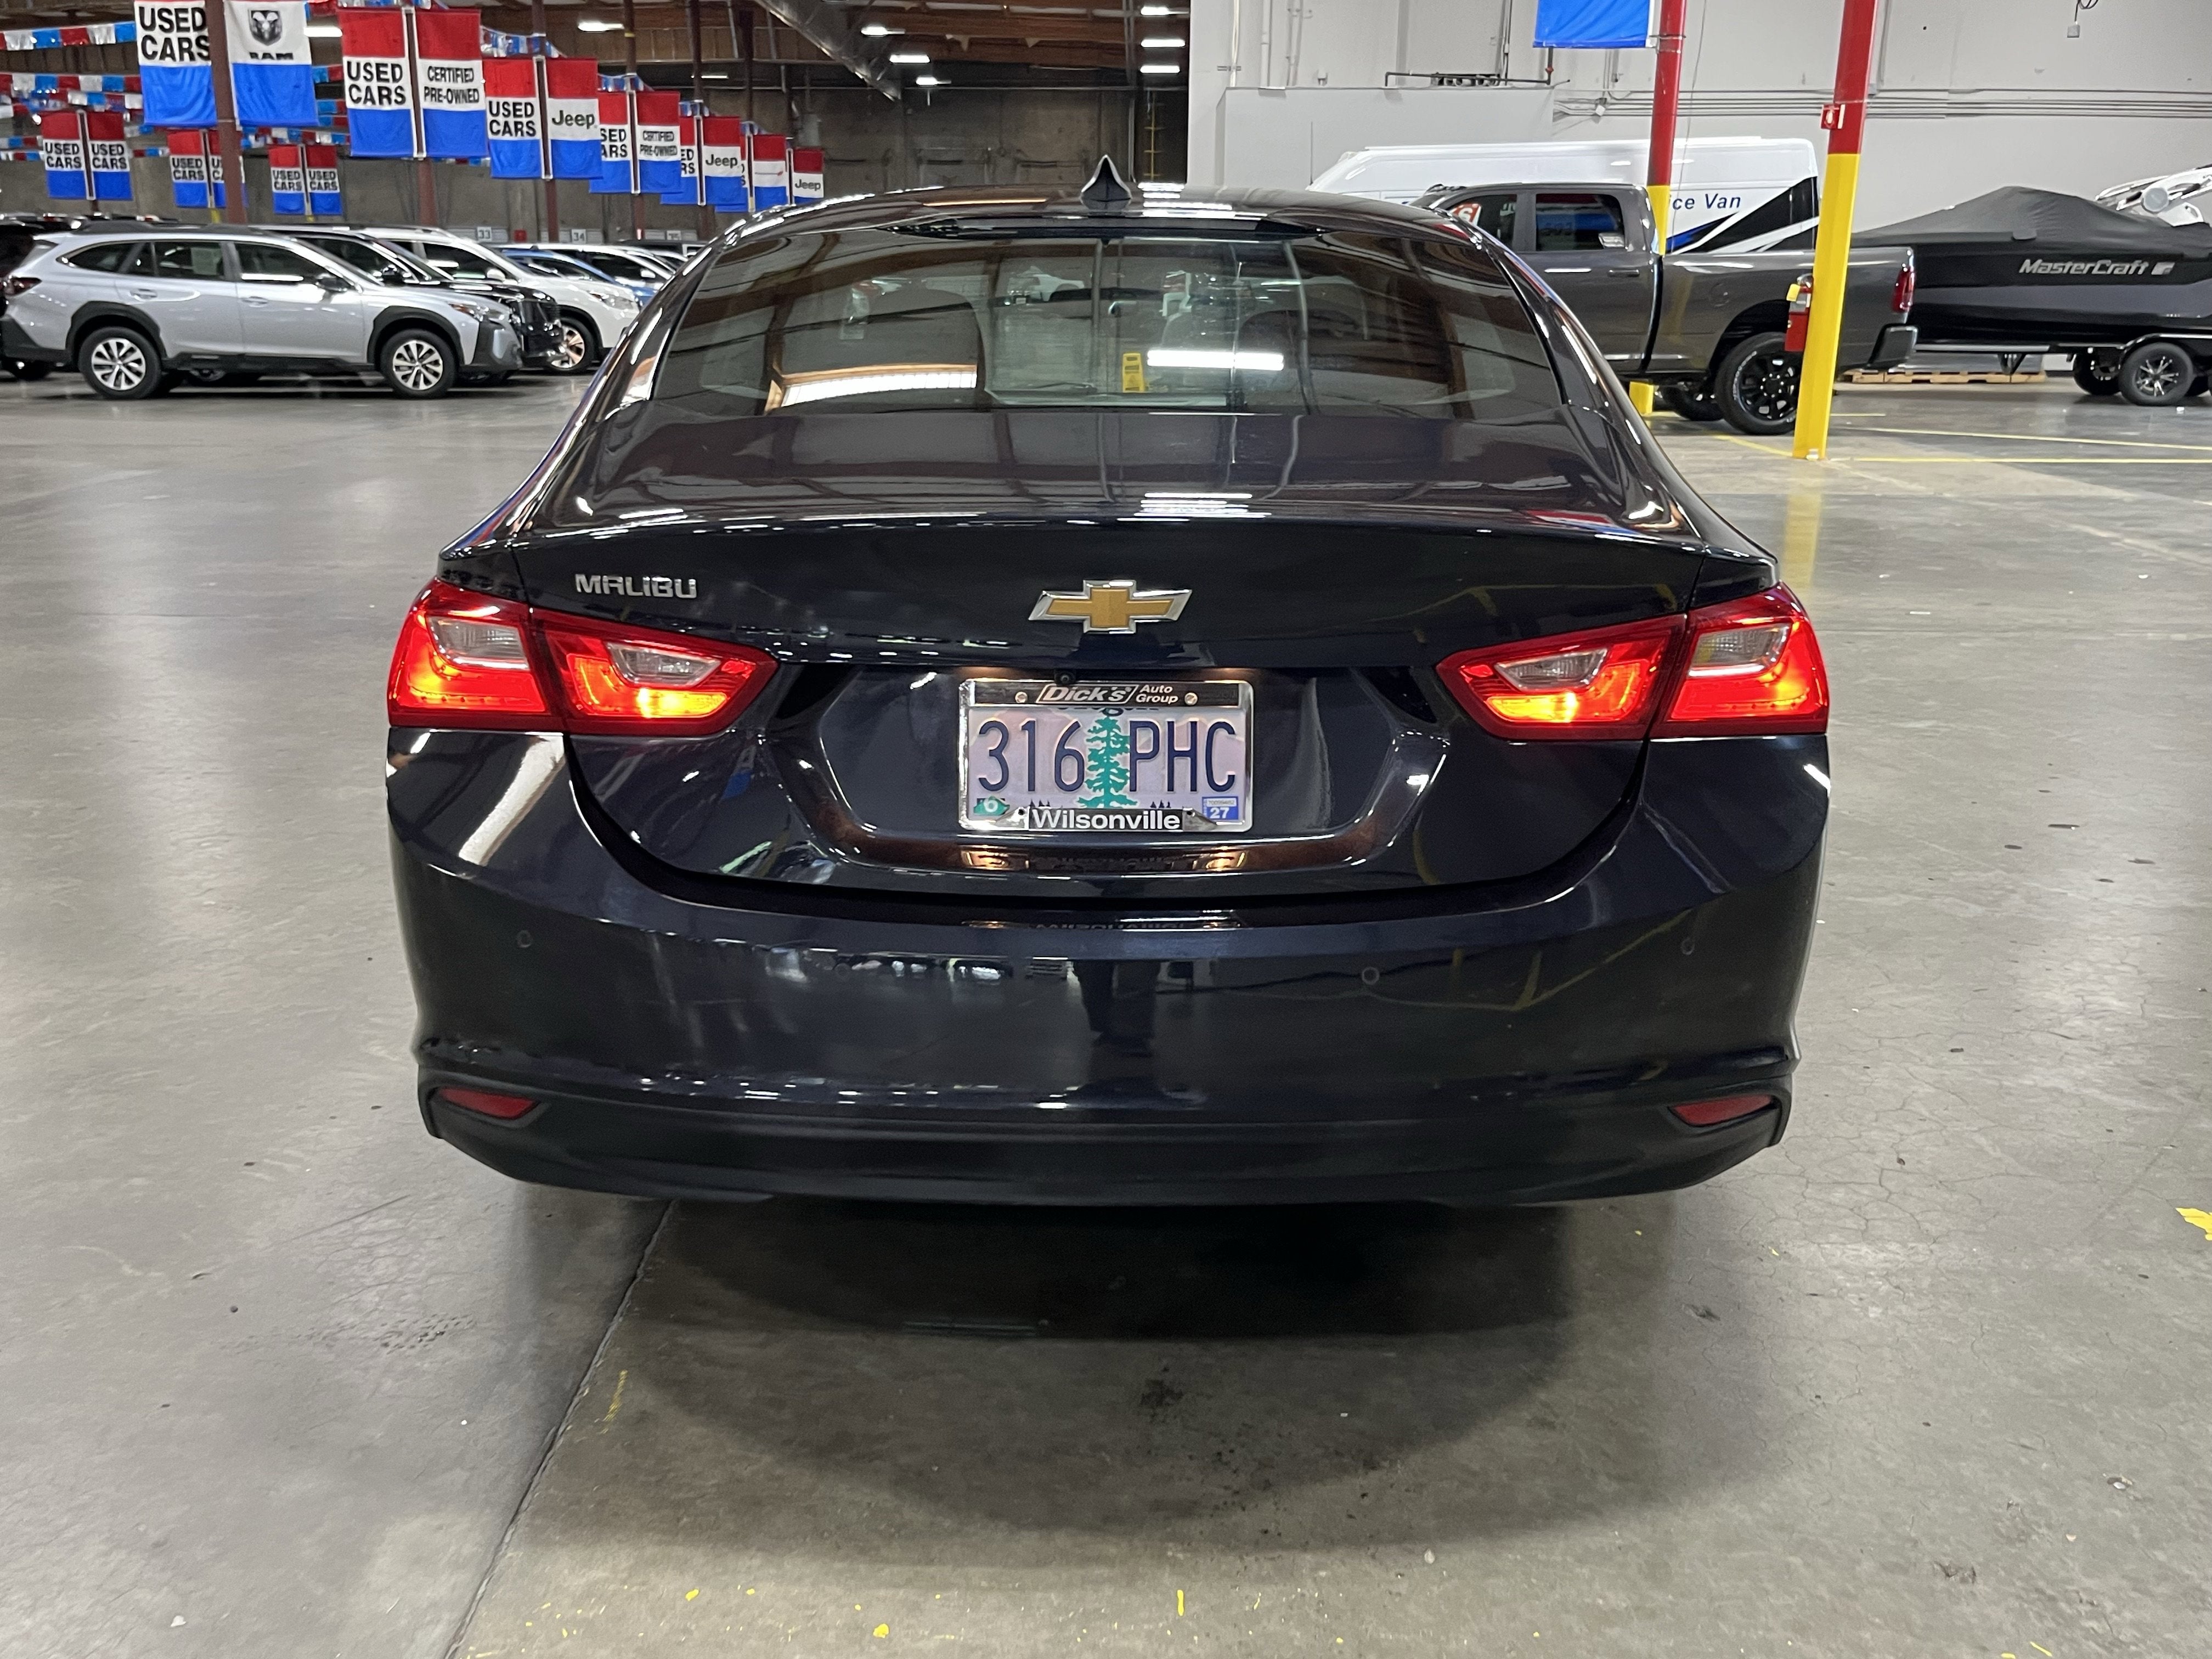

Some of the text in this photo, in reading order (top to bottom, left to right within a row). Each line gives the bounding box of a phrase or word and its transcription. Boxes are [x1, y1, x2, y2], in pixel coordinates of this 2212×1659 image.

[139, 7, 206, 33] USED
[141, 35, 210, 61] CARS
[347, 61, 403, 83] USED
[427, 66, 474, 82] CERTIFIED
[348, 84, 406, 105] CARS
[424, 86, 479, 104] PRE-OWNED
[488, 101, 534, 118] USED
[552, 110, 595, 129] Jeep
[489, 120, 537, 137] CARS
[600, 128, 627, 142] SED
[45, 142, 80, 155] USED
[91, 144, 124, 156] USED
[601, 144, 628, 158] ARS
[46, 156, 82, 168] CARS
[92, 157, 127, 169] CARS
[172, 157, 202, 168] USED
[706, 154, 738, 168] Jeep
[173, 170, 204, 180] CARS
[273, 170, 300, 180] USED
[308, 171, 336, 180] USED
[274, 181, 302, 191] CARS
[309, 181, 337, 190] CARS
[795, 179, 821, 191] Jeep
[1705, 193, 1741, 208] Van
[478, 230, 490, 239] 33
[573, 232, 585, 241] 34
[2019, 259, 2149, 275] MasterCraft
[575, 574, 697, 599] MALIBU
[1043, 685, 1173, 701] Dick's Auto
[1136, 694, 1178, 704] Group
[978, 720, 1235, 792] 316 PHC
[1032, 809, 1181, 829] Wilsonville
[1210, 807, 1229, 819] 27
